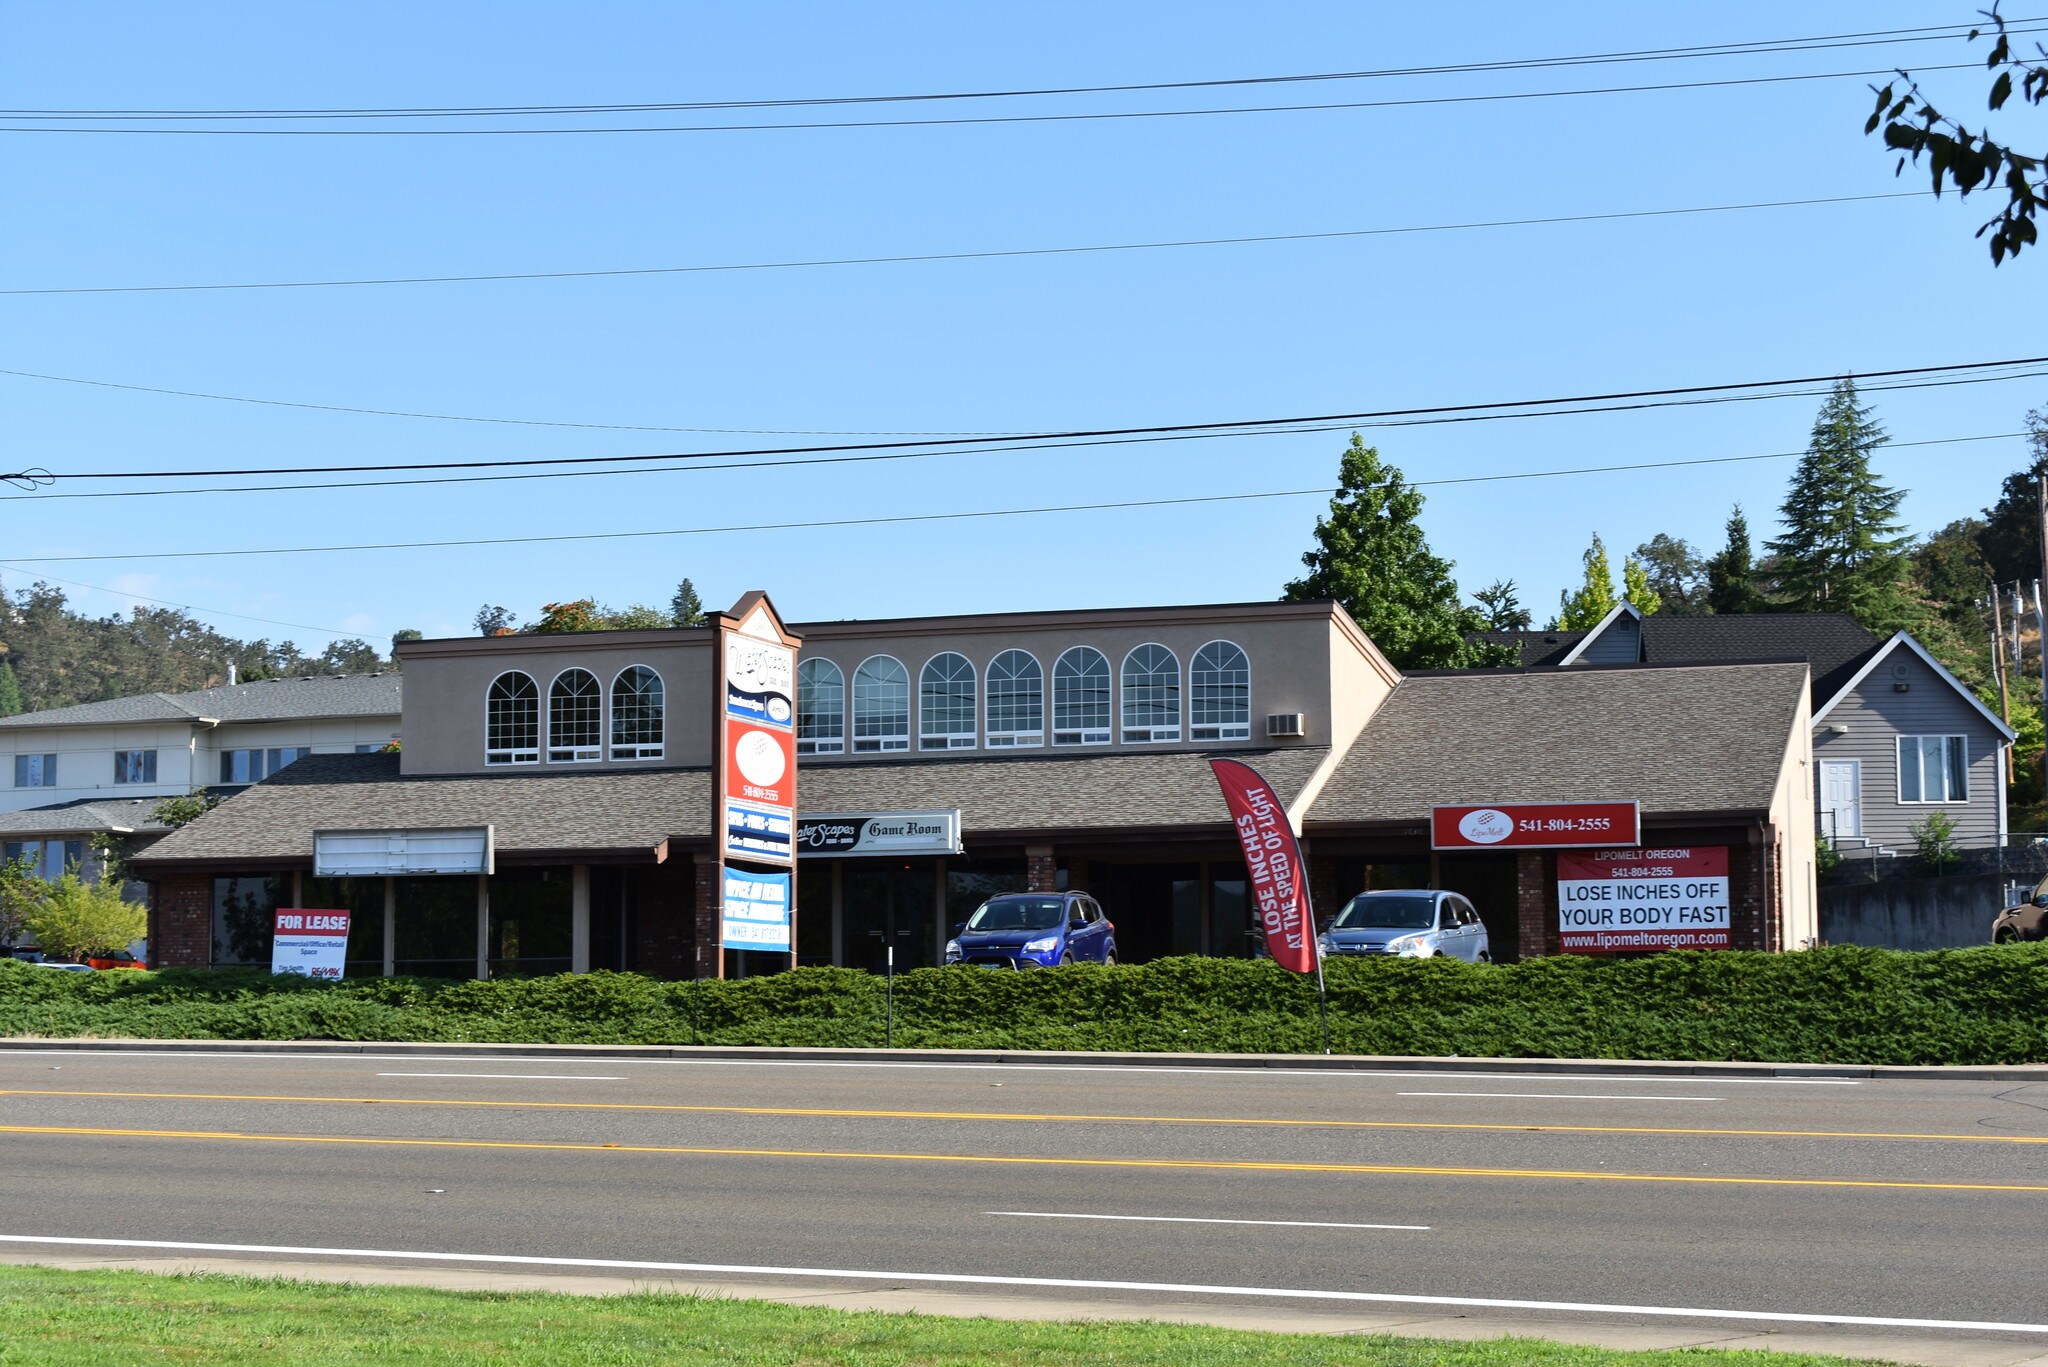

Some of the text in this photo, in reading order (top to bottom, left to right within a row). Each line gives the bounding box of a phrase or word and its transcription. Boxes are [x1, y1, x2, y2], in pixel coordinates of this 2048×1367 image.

[868, 822, 942, 836] Game Room
[1519, 818, 1611, 832] 541-804-2555
[1595, 849, 1690, 861] LIPOMELT OREGON
[1237, 814, 1282, 935] LOSE INCHES
[1246, 787, 1304, 949] AT THE SPEED OF LIGHT
[1611, 866, 1673, 878] 541-804-2555
[1566, 883, 1720, 901] LOSE INCHES OFF
[277, 915, 347, 930] FOR LEASE
[1562, 906, 1727, 926] YOUR BODY FAST
[275, 940, 345, 948] Commercial/Office/Retail
[1563, 932, 1728, 948] www.lipomeltoregon.com
[300, 948, 318, 956] Space
